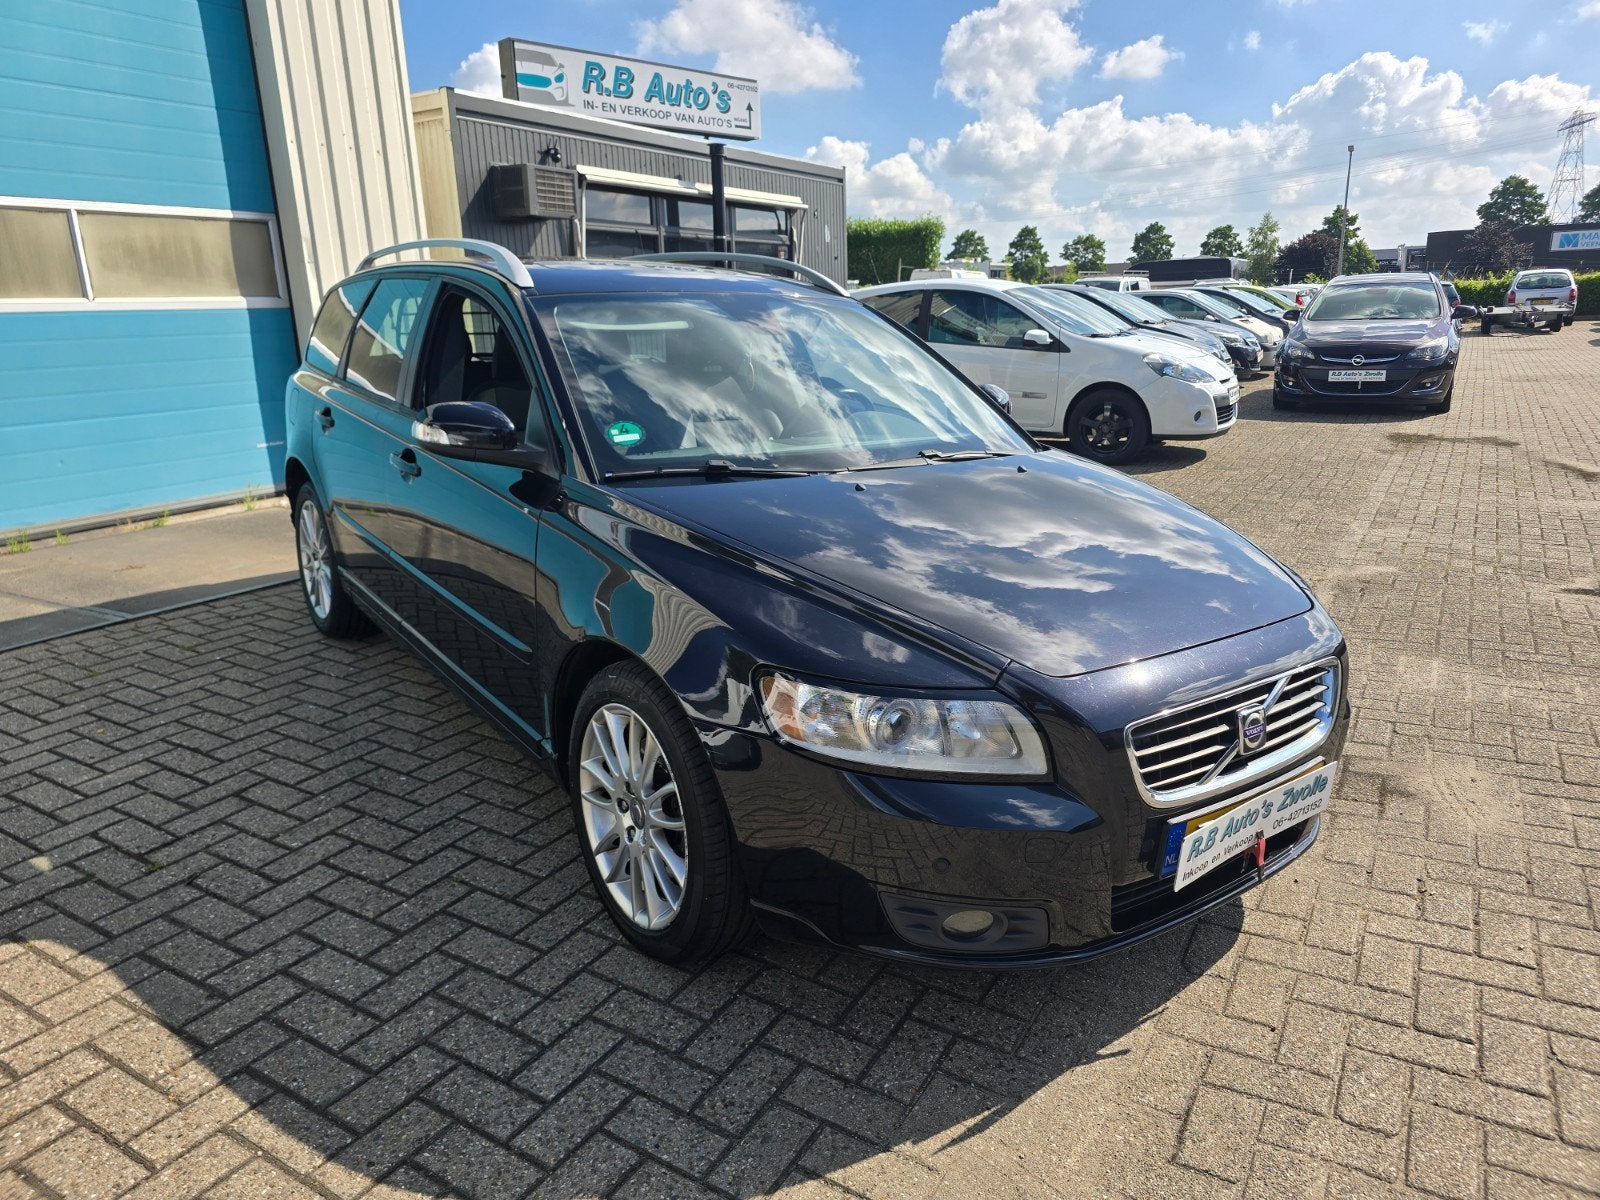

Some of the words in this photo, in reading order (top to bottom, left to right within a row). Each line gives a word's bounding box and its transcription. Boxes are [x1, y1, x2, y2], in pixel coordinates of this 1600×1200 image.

[582, 61, 634, 99] R.B
[644, 72, 732, 114] Auto's
[583, 99, 598, 110] IN-
[601, 102, 617, 113] EN
[619, 104, 672, 120] VERKOOP
[674, 112, 695, 123] VAN
[697, 115, 732, 128] AUTO'S
[1187, 826, 1219, 862] R.B
[1220, 799, 1273, 842] Auto's
[1277, 774, 1329, 812] Zwolle
[1273, 799, 1322, 829] 06-42713152
[1165, 854, 1177, 866] NL
[1182, 860, 1209, 881] Inkoop
[1211, 853, 1221, 864] en
[1224, 833, 1254, 856] Verkoop
